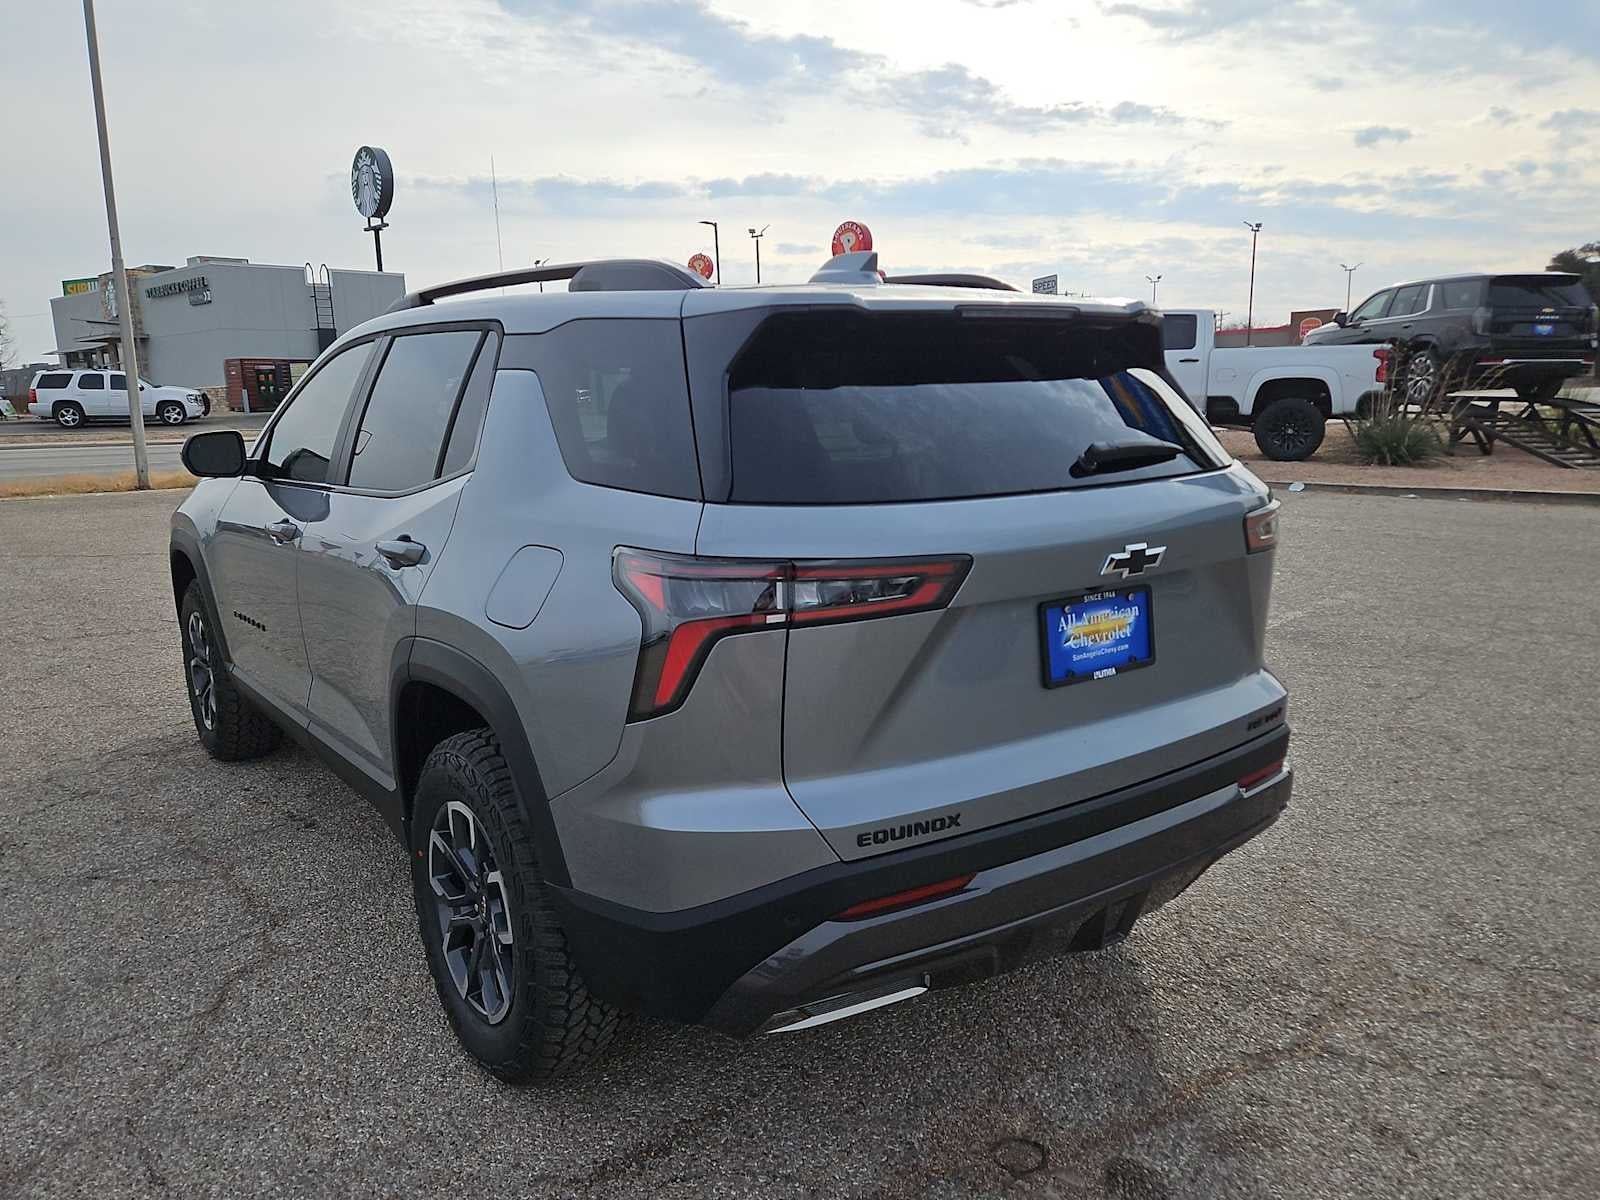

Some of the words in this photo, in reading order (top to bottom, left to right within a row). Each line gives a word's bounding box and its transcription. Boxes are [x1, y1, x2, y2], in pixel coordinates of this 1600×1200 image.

[1083, 592, 1103, 603] SINCE
[1058, 613, 1076, 632] All
[1079, 605, 1140, 627] American
[1070, 626, 1132, 649] Chevrolet
[857, 813, 962, 848] EQUINOX
